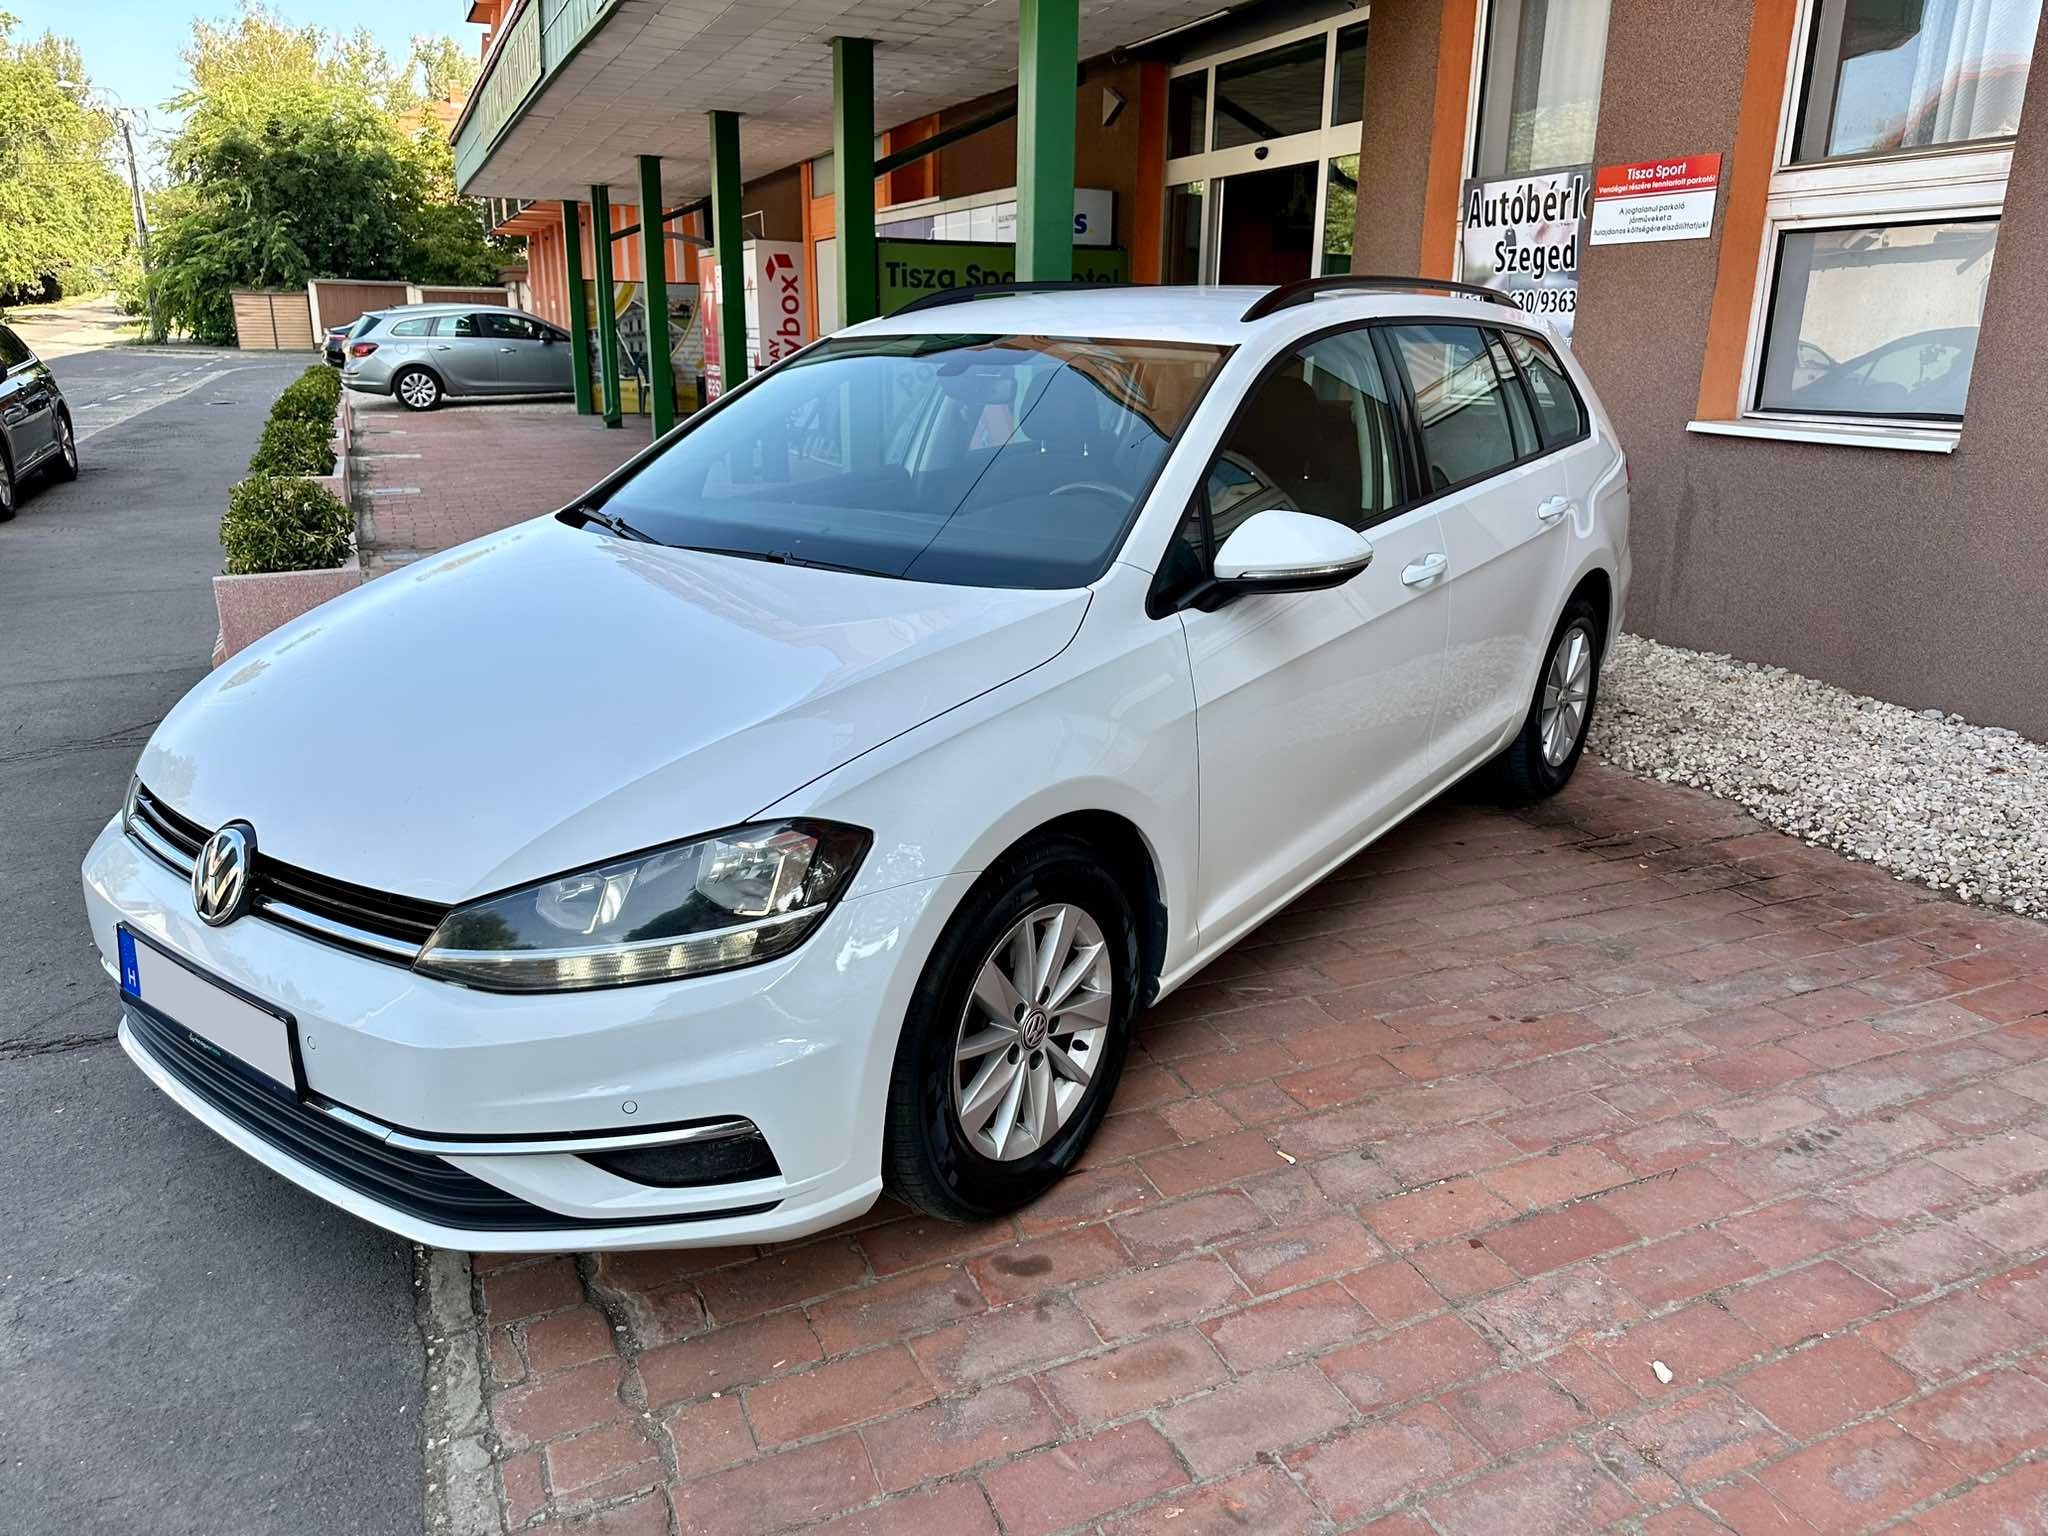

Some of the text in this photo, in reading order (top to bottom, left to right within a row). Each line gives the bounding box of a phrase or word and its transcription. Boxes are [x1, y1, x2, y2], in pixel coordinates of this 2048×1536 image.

[1627, 162, 1687, 180] Tisza Sport
[1619, 207, 1625, 215] A
[1658, 202, 1685, 213] parkoló
[1495, 234, 1576, 280] Szeged
[885, 261, 957, 288] Tisza
[966, 263, 1016, 286] Spo
[777, 275, 802, 356] ybox
[127, 967, 137, 988] H
